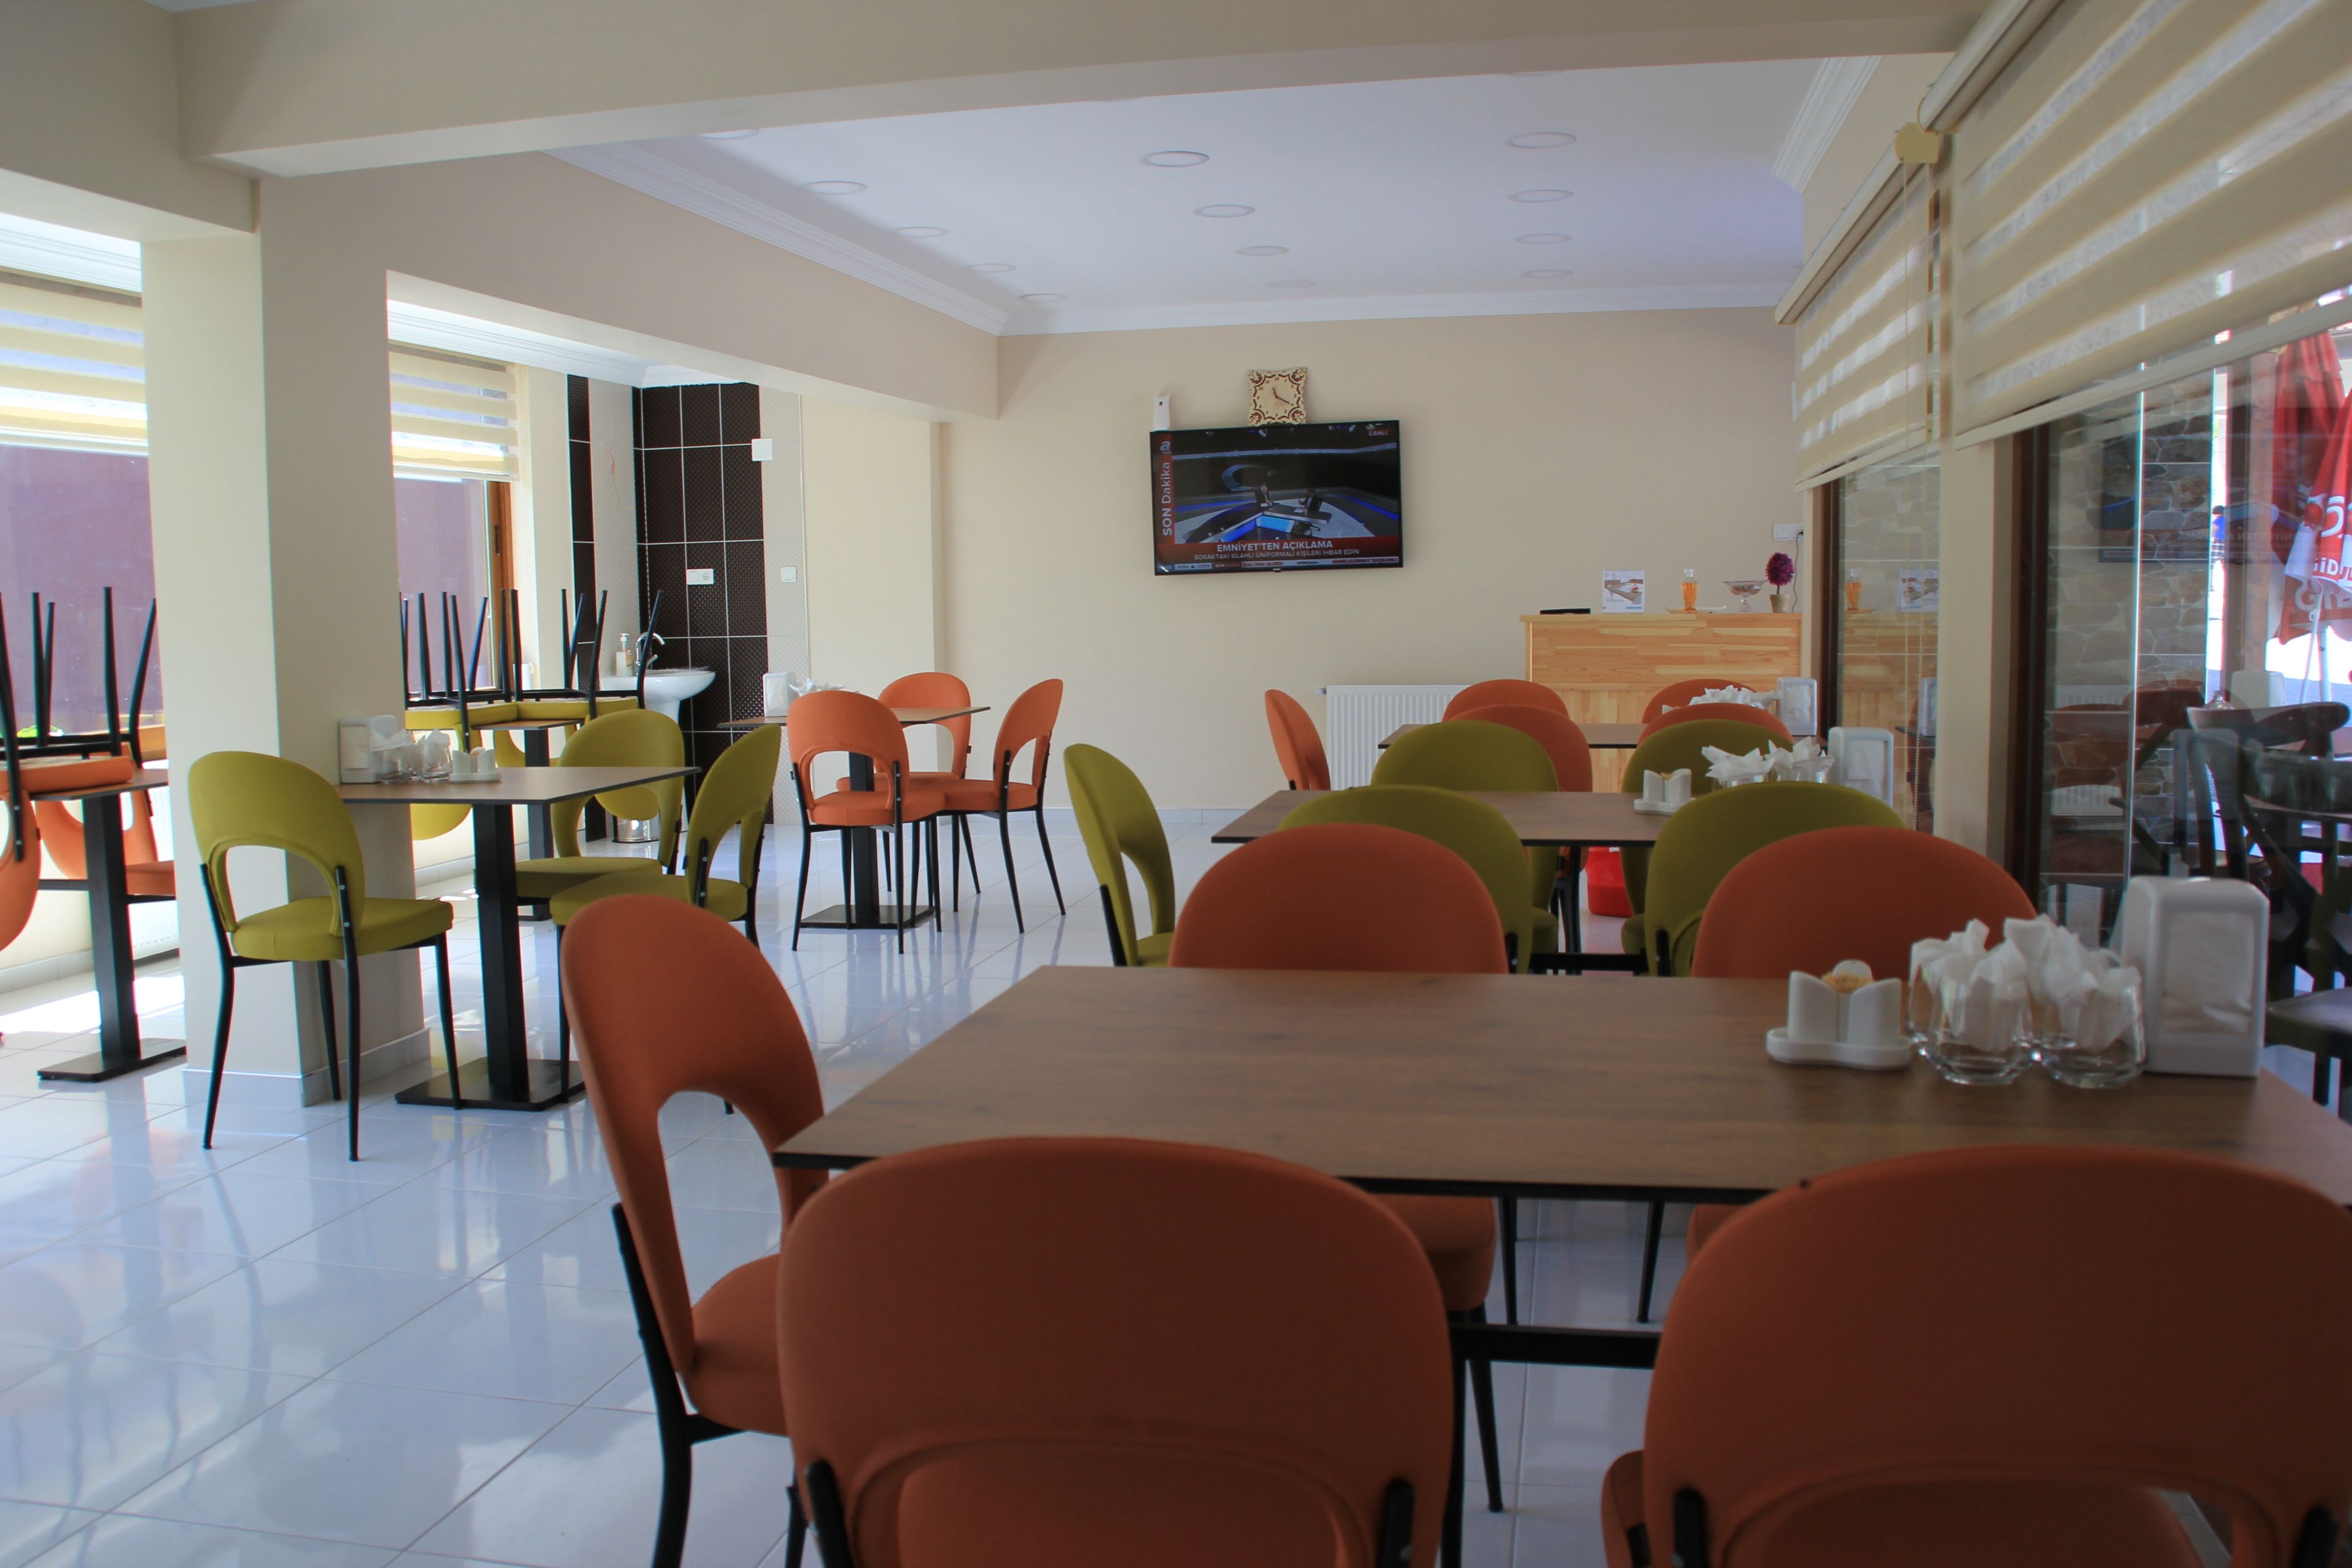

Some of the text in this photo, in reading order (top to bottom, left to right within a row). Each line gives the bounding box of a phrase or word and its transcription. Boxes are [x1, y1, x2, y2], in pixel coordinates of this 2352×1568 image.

[1161, 462, 1171, 504] Dakika
[1163, 508, 1172, 536] SON
[1282, 540, 1333, 550] AÇIKLAMA
